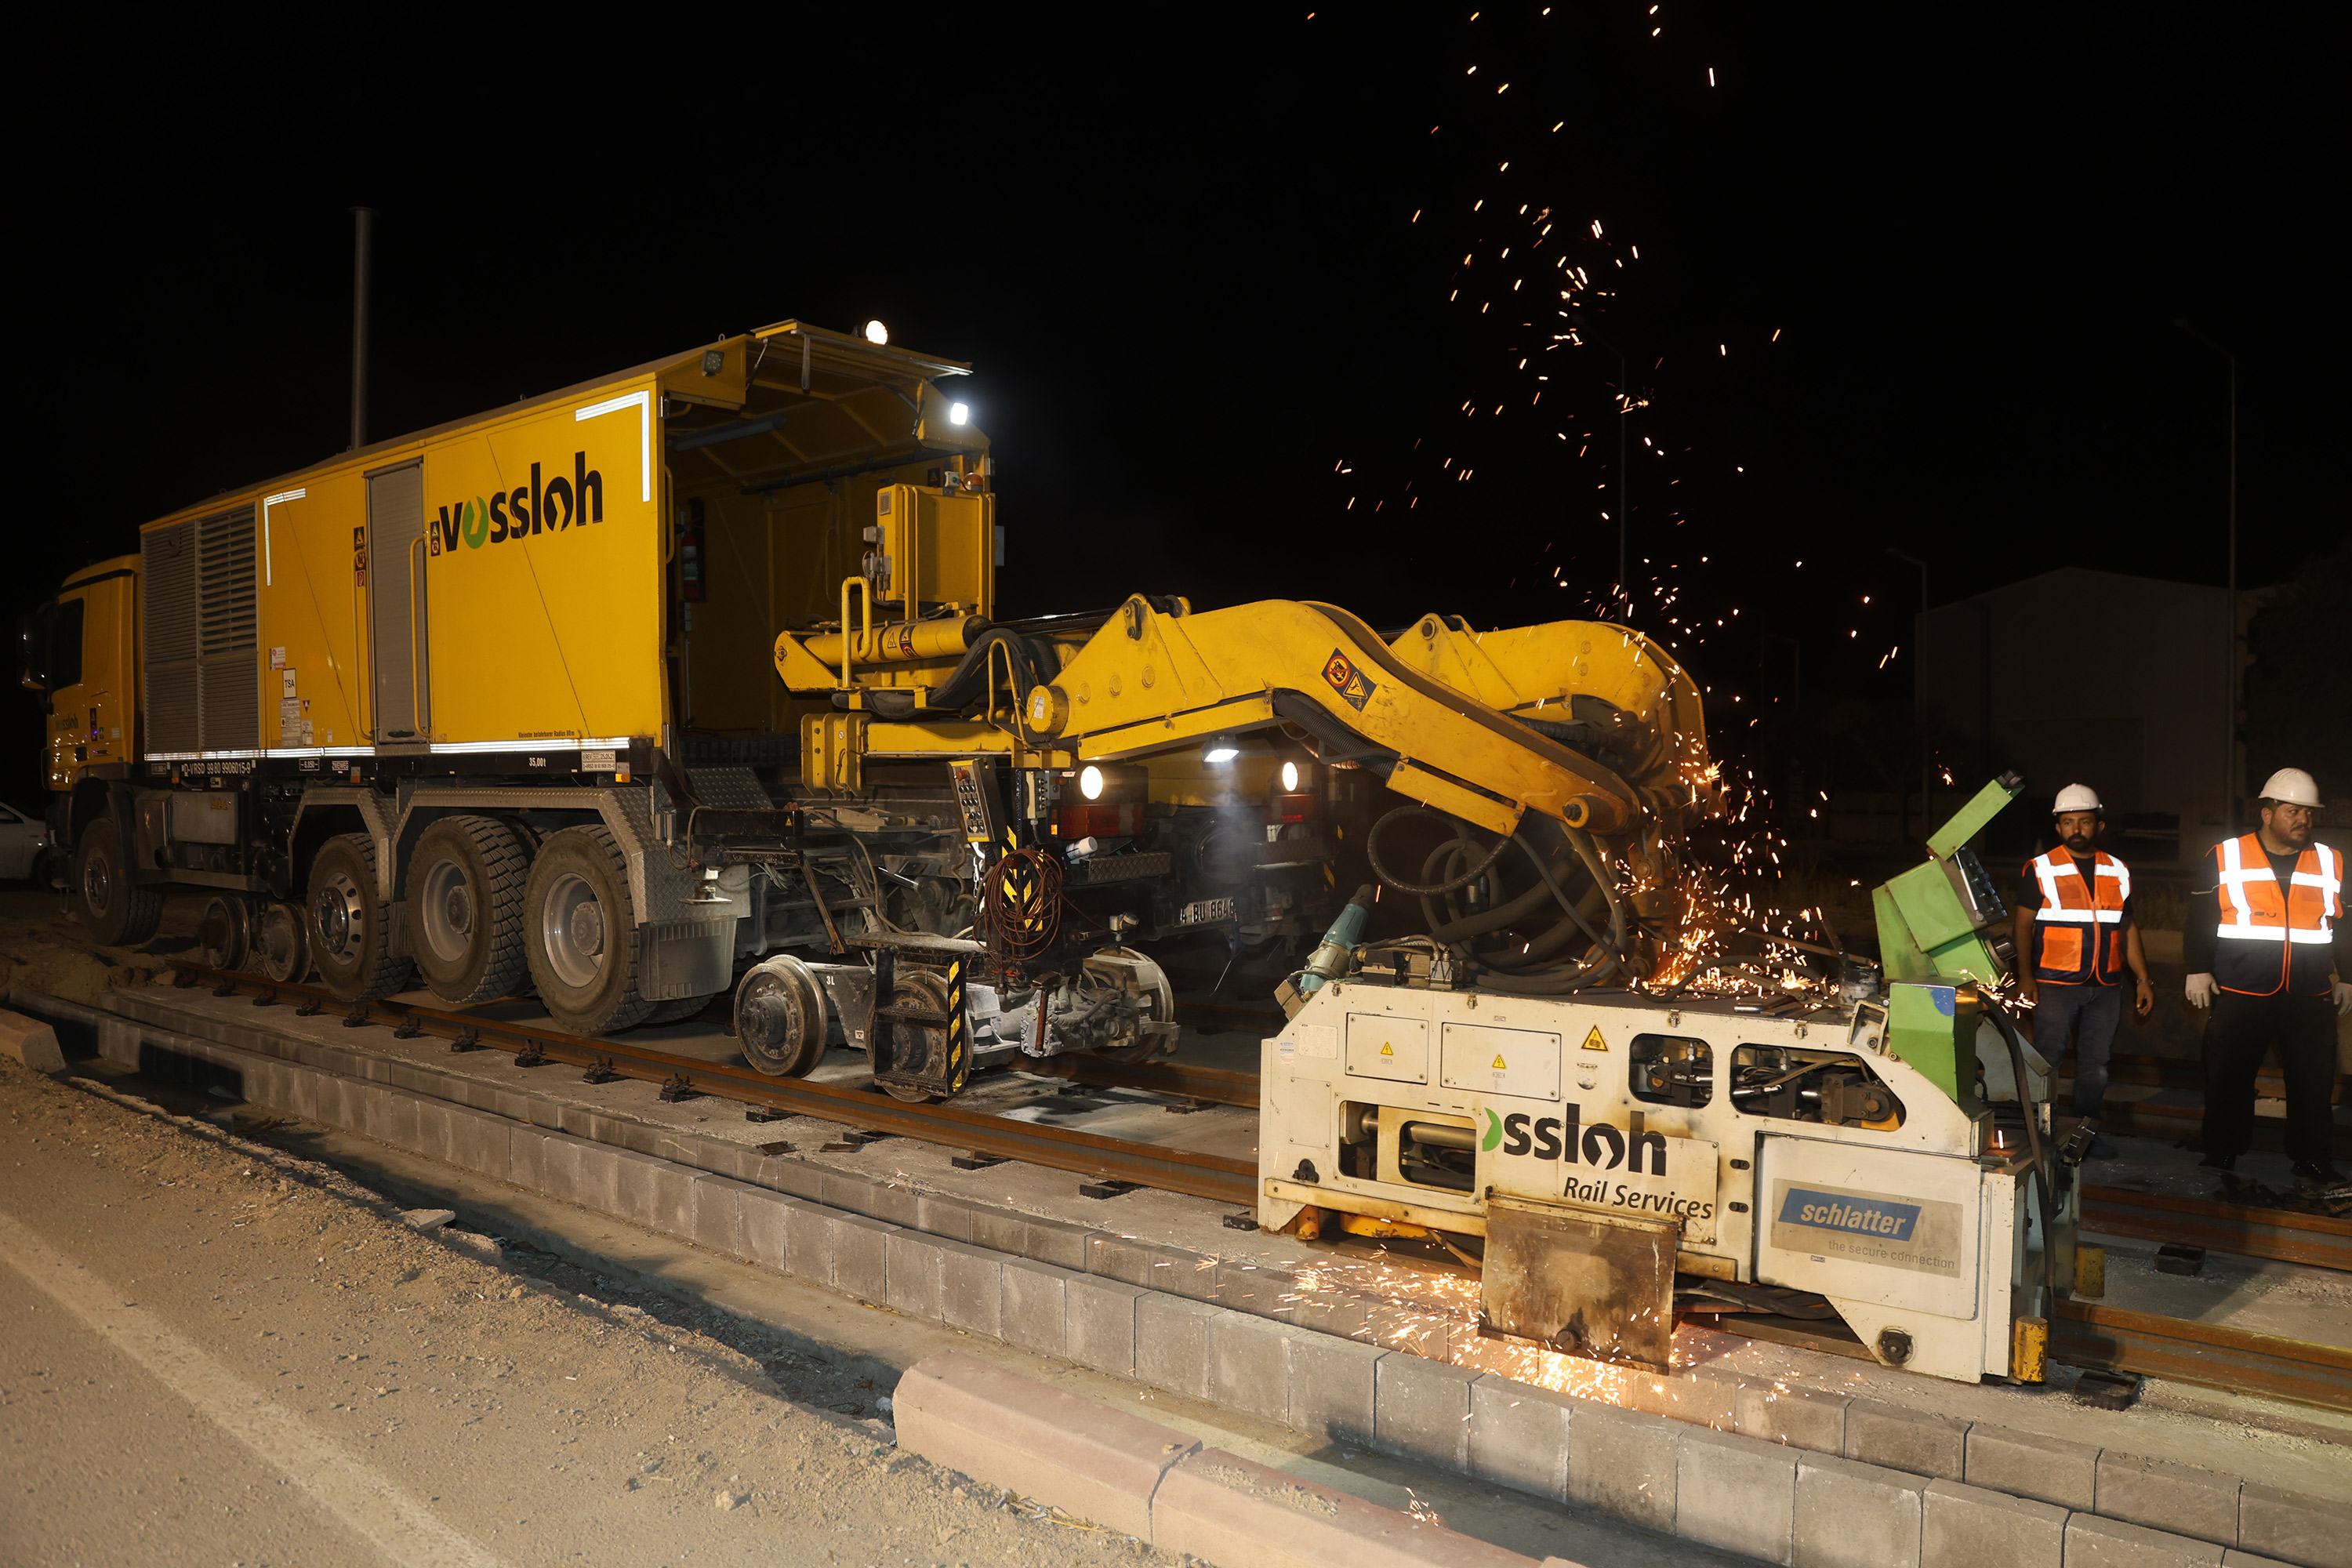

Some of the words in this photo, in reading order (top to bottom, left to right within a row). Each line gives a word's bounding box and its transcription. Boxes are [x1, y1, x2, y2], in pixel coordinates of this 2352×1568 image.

[439, 451, 603, 552] vossloh
[285, 679, 295, 688] TSA
[1192, 902, 1206, 923] BU
[826, 975, 836, 985] 3L
[1563, 1177, 1608, 1203] Rail
[1613, 1184, 1714, 1220] Services
[1800, 1203, 1907, 1235] schlatter
[1828, 1240, 1846, 1252] the
[1849, 1243, 1888, 1258] secure
[1890, 1251, 1955, 1270] connection
